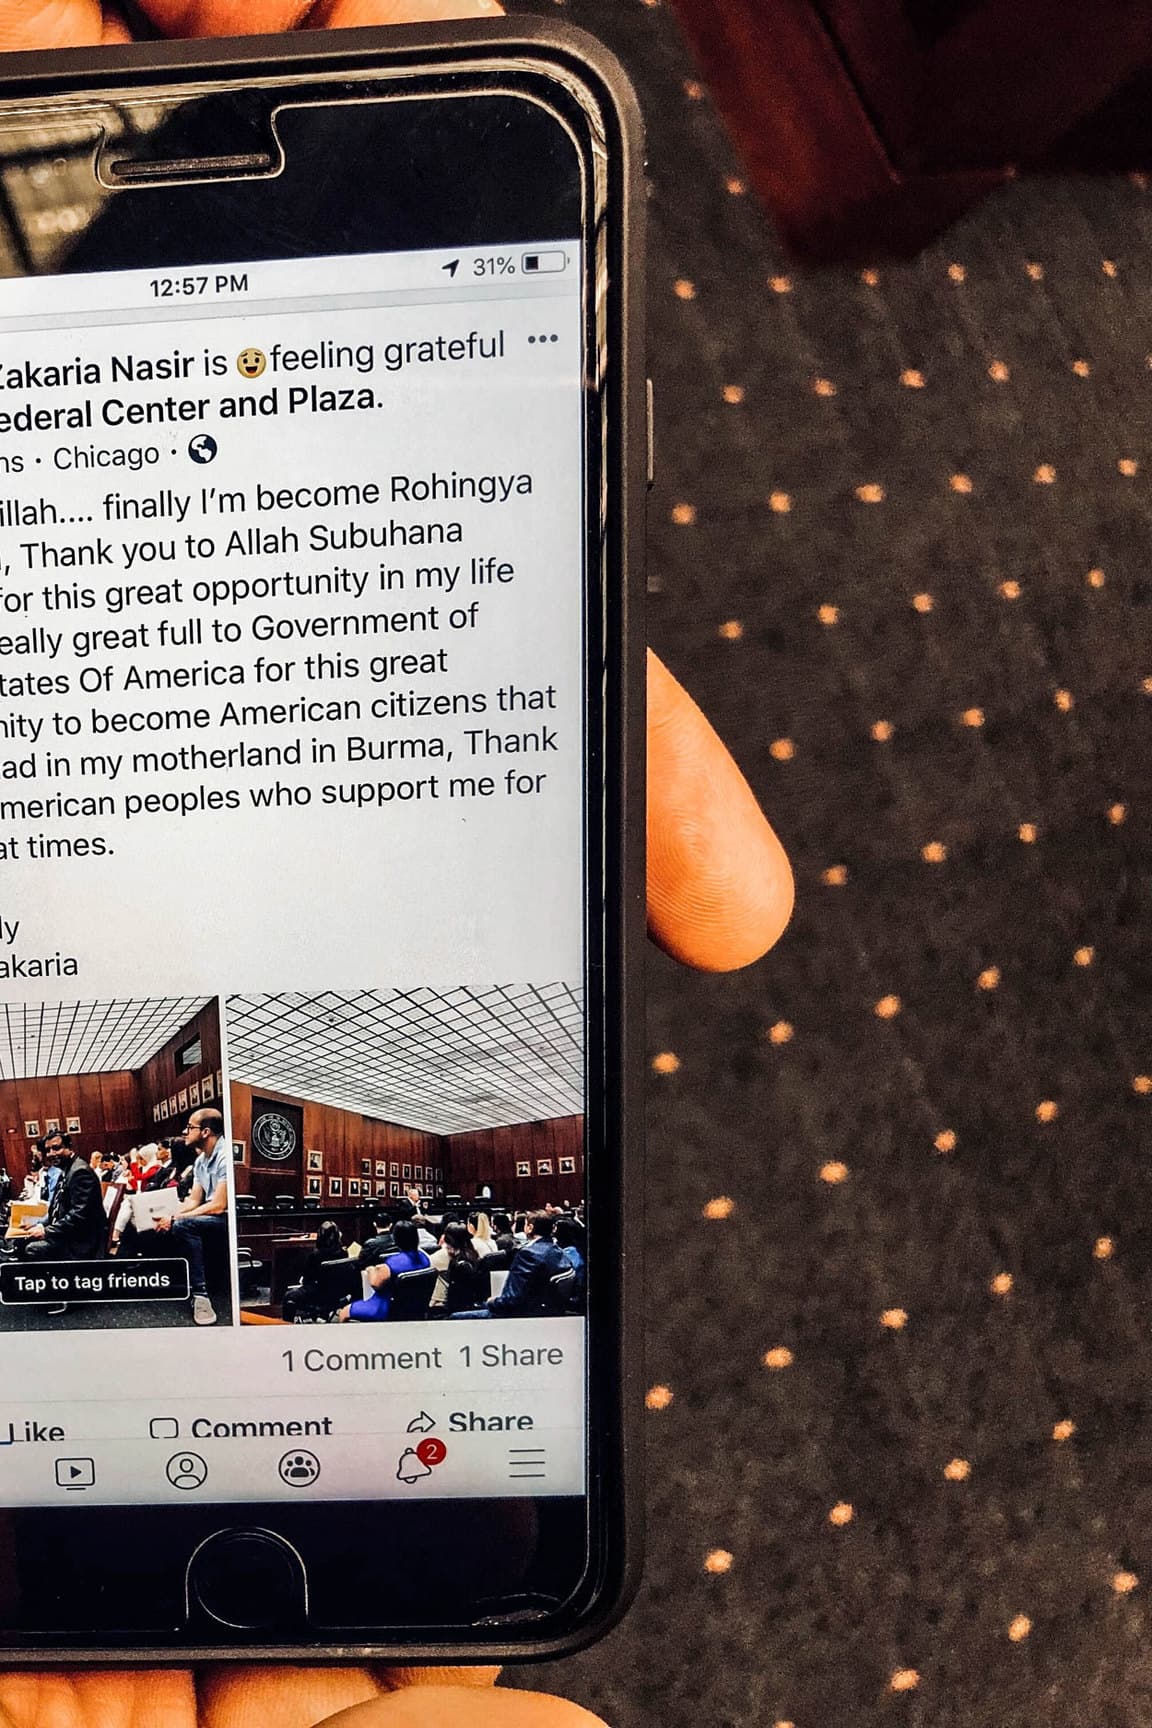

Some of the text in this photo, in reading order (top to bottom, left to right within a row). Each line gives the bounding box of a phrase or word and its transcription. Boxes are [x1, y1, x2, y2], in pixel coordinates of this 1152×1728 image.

[473, 255, 516, 277] 31%
[150, 273, 249, 298] 12:57 PM
[111, 350, 196, 382] Nasir
[204, 347, 229, 376] is
[270, 340, 375, 373] feeling
[384, 330, 505, 372] grateful
[102, 397, 210, 426] Center
[220, 387, 278, 418] and
[289, 385, 383, 413] Plaza.
[54, 443, 160, 471] Chicago
[103, 490, 191, 523] finally
[257, 484, 379, 511] become
[391, 471, 532, 503] Rohingya
[20, 538, 114, 568] Thank
[122, 541, 175, 569] you
[185, 535, 215, 559] to
[225, 526, 298, 557] Allah
[309, 520, 462, 551] Subuhana
[42, 582, 95, 610] this
[106, 579, 183, 613] great
[193, 566, 369, 606] opportunity
[380, 564, 404, 590] in
[416, 566, 460, 592] my
[472, 557, 514, 584] life
[73, 624, 149, 657] great
[157, 618, 201, 646] full
[211, 619, 241, 643] to
[252, 606, 439, 640] Government
[449, 601, 479, 629] of
[80, 666, 114, 693] Of
[123, 660, 244, 690] America
[254, 657, 296, 683] for
[304, 652, 359, 680] this
[370, 649, 448, 682] great
[52, 713, 81, 735] to
[92, 708, 210, 733] become
[220, 697, 360, 727] American
[371, 690, 487, 718] citizens
[496, 685, 556, 711] that
[46, 752, 70, 777] in
[81, 755, 123, 780] my
[133, 739, 301, 773] motherland
[312, 738, 335, 763] in
[347, 737, 452, 762] Burma,
[464, 726, 558, 755] Thank
[125, 785, 240, 819] peoples
[249, 781, 311, 807] who
[322, 776, 439, 808] support
[450, 777, 495, 797] me
[504, 769, 547, 794] for
[26, 834, 114, 858] times.
[15, 1271, 171, 1293] Tap to tag friends
[282, 1343, 564, 1373] 1 Comment 1 Share
[8, 1420, 66, 1442] Like
[191, 1416, 334, 1438] Comment
[448, 1411, 534, 1432] Share
[426, 1444, 438, 1460] 2
